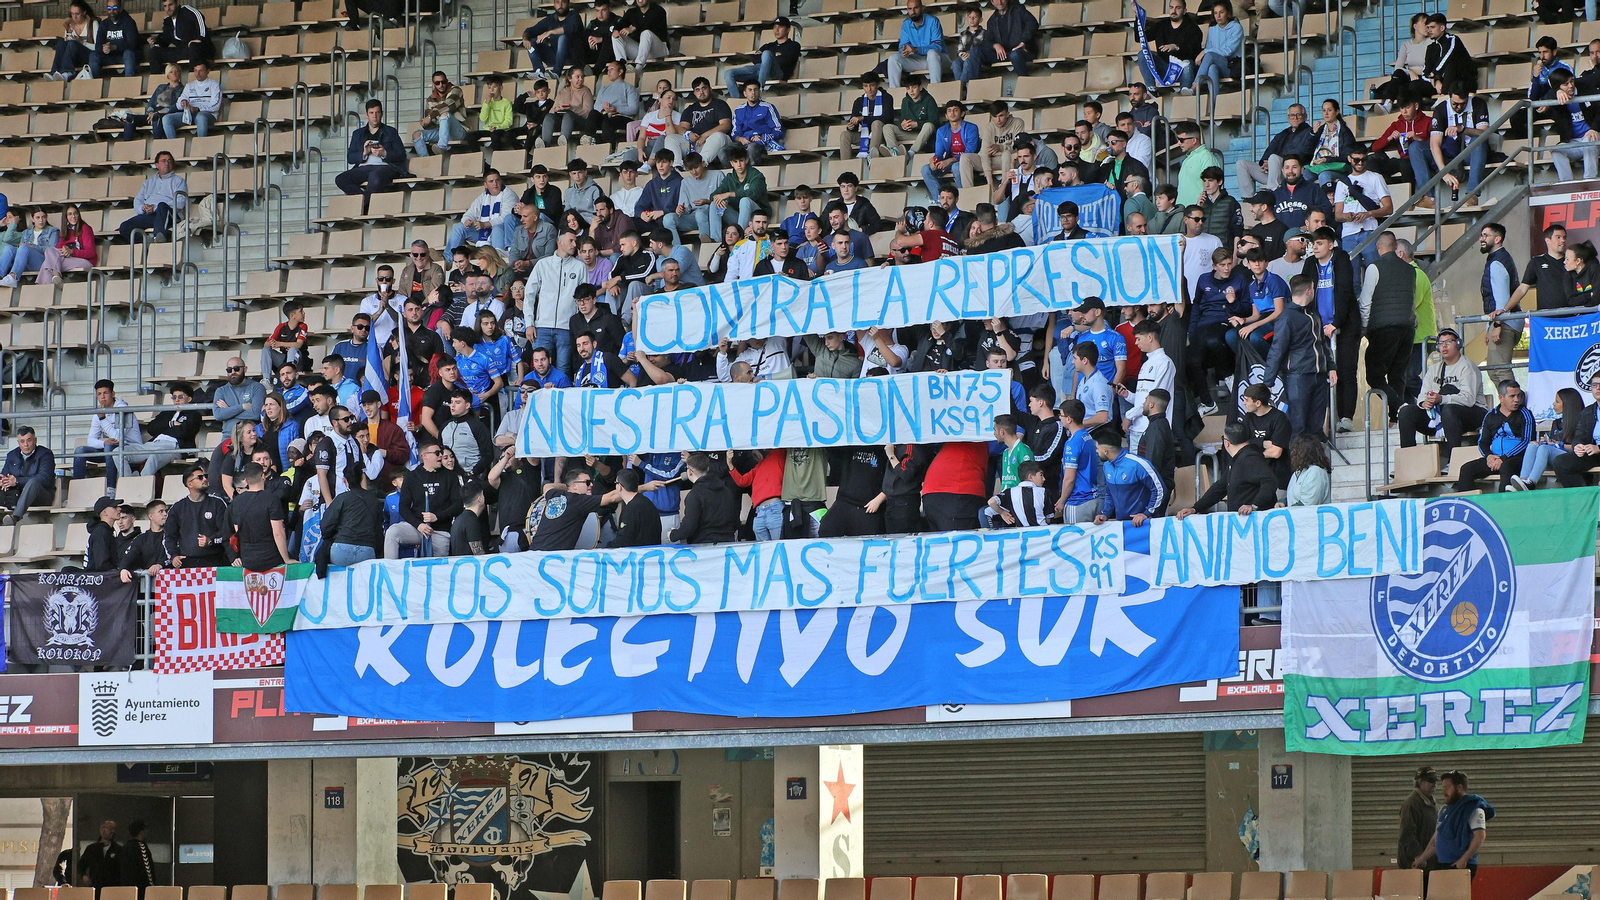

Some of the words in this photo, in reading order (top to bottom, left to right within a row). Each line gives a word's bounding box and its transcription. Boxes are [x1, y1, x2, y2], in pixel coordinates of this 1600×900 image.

[1035, 193, 1117, 245] KOLTIVO
[1276, 201, 1307, 213] ellesse
[640, 275, 834, 352] CONTRA
[852, 266, 909, 328] LA
[926, 234, 1181, 321] REPRESION
[1544, 324, 1588, 340] XEREZ
[928, 373, 1003, 402] BN75
[523, 384, 733, 454] NUESTRA
[751, 376, 922, 446] PASION
[930, 404, 995, 436] KS91
[1090, 533, 1119, 560] KS
[1155, 509, 1296, 586] ANIMO
[1317, 499, 1418, 578] BENI
[38, 573, 103, 586] KOMANDO
[300, 556, 512, 624] JUNTOS
[534, 549, 701, 617] SOMOS
[855, 525, 1087, 604] FUERTES
[1090, 562, 1113, 589] 91
[1407, 540, 1474, 645] XEREZ
[176, 591, 259, 651] BIR
[1387, 626, 1497, 675] DEPORTIVO
[125, 697, 200, 710] Ayuntamiento
[1227, 685, 1272, 694] EXPLORA,
[125, 711, 138, 721] de
[139, 710, 167, 723] Jerez
[230, 690, 300, 719] PL
[1305, 682, 1584, 743] XEREZ
[0, 725, 31, 735] FRUTA,
[34, 724, 72, 734] COMPITE.
[165, 764, 180, 773] Exit
[421, 774, 442, 797] 19
[518, 767, 539, 790] 91
[1273, 775, 1289, 785] 117
[326, 796, 341, 806] 118
[788, 786, 803, 797] 17
[457, 788, 504, 844] XEREZ
[430, 844, 534, 856] Hooligans
